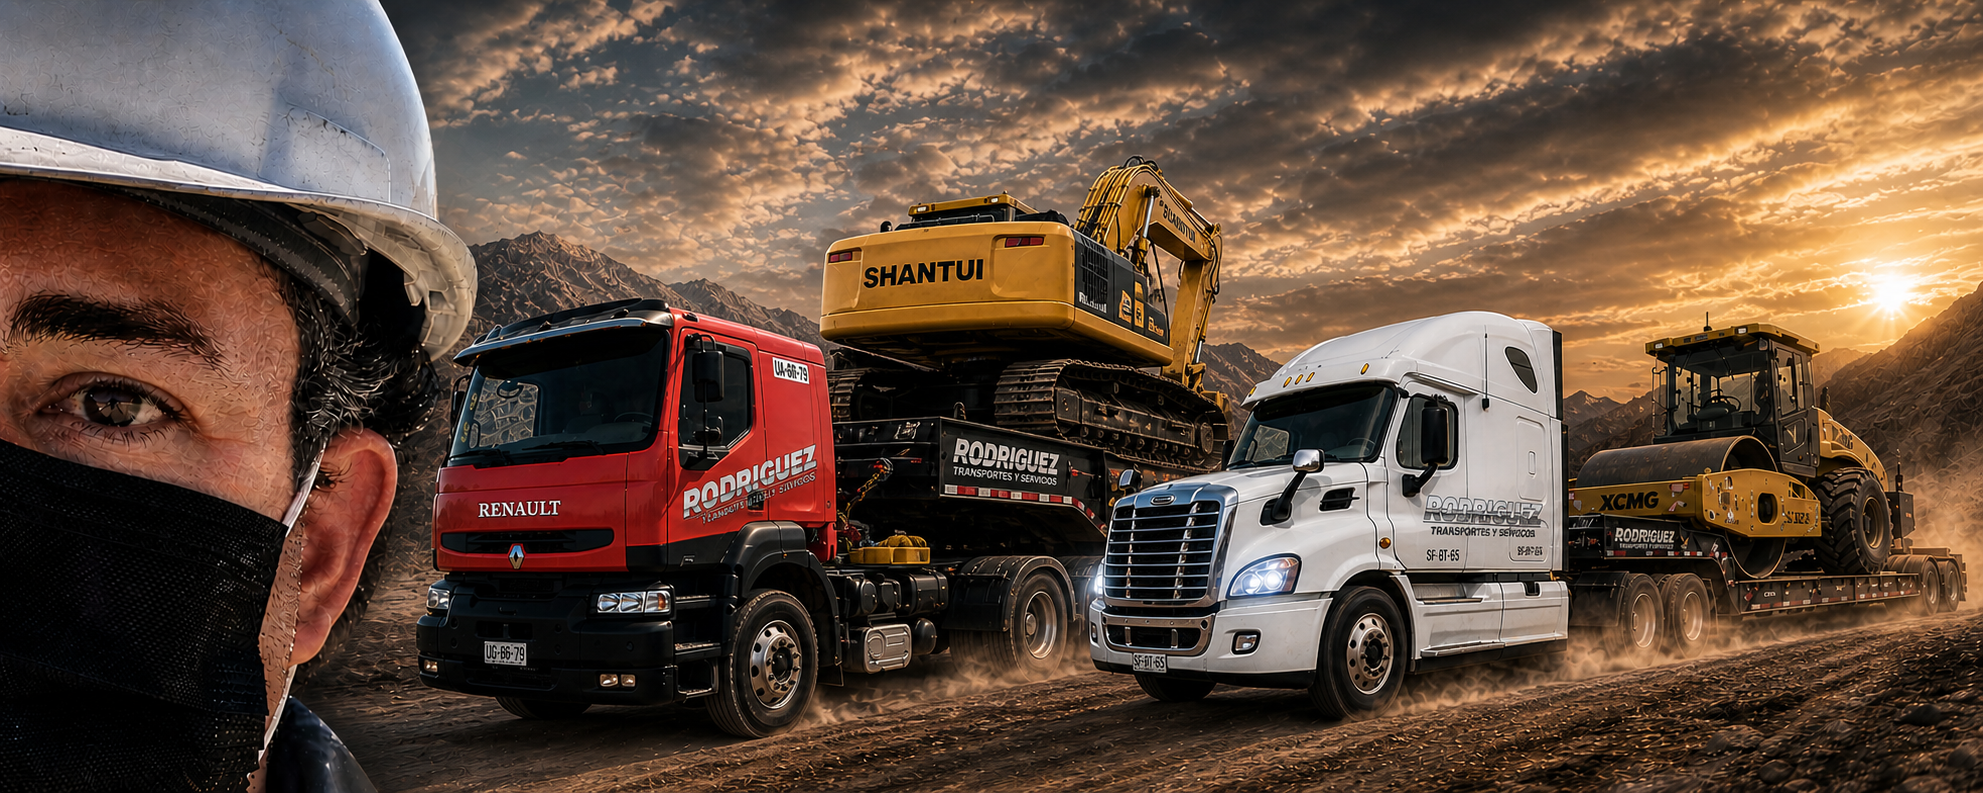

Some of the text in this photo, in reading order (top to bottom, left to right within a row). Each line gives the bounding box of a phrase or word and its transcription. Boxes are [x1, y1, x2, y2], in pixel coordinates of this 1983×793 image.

[863, 258, 984, 289] SHANTUI
[953, 437, 1060, 476] RODRIGUEZ
[683, 443, 818, 520] RODRIGUEZ
[953, 466, 1013, 482] TRANSPORTES
[1014, 472, 1020, 482] Y
[477, 500, 562, 518] RENAULT
[1423, 494, 1544, 527] RODRIGUEZ
[1599, 491, 1660, 512] XCMG
[1614, 527, 1675, 544] RODRIGUEZ
